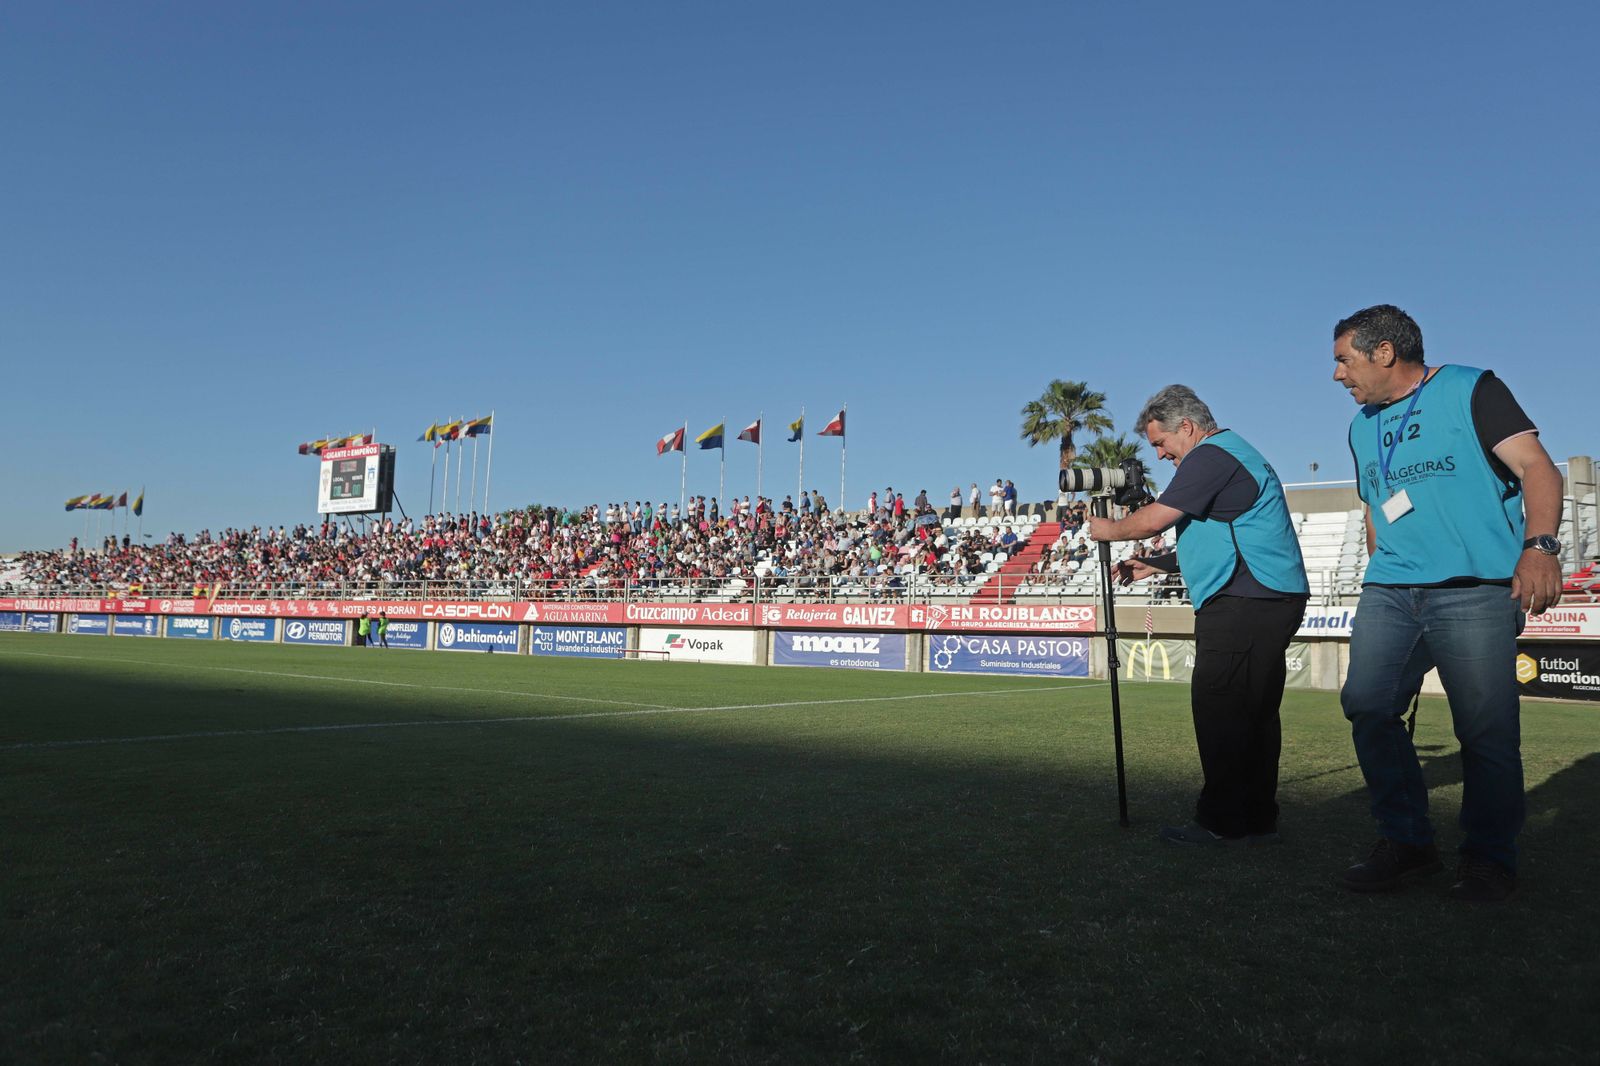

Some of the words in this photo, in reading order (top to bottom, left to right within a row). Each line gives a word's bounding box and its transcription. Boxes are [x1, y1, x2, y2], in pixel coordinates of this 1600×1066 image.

[342, 605, 376, 614] HOTELES
[377, 604, 416, 615] ALBORÁN
[422, 603, 512, 618] CASOPLÓN
[626, 604, 697, 623] Cruzcampo
[701, 607, 749, 621] Adedi
[786, 608, 837, 623] Relojería
[842, 607, 896, 625] GALVEZ
[951, 607, 975, 620] EN
[979, 607, 1093, 621] ROJIBLANCO
[543, 612, 572, 621] AGUA
[573, 612, 608, 622] MARINA
[1527, 612, 1588, 624] ESQUINA
[308, 622, 343, 632] HYUNDAI
[308, 632, 343, 641] PERMOTOR
[457, 628, 516, 645] Bahiamóvil
[556, 630, 584, 644] MONT
[586, 631, 623, 645] BLANC
[556, 644, 590, 653] lavandería
[688, 638, 724, 652] Vopak
[791, 635, 880, 654] moonz
[967, 639, 1011, 655] CASA
[1018, 640, 1082, 657] PASTOR
[840, 659, 880, 668] ortodoncia
[980, 659, 1020, 668] Suministros
[1021, 660, 1062, 670] Industriales
[1540, 657, 1579, 671] futbol
[1540, 672, 1600, 685] emotion
